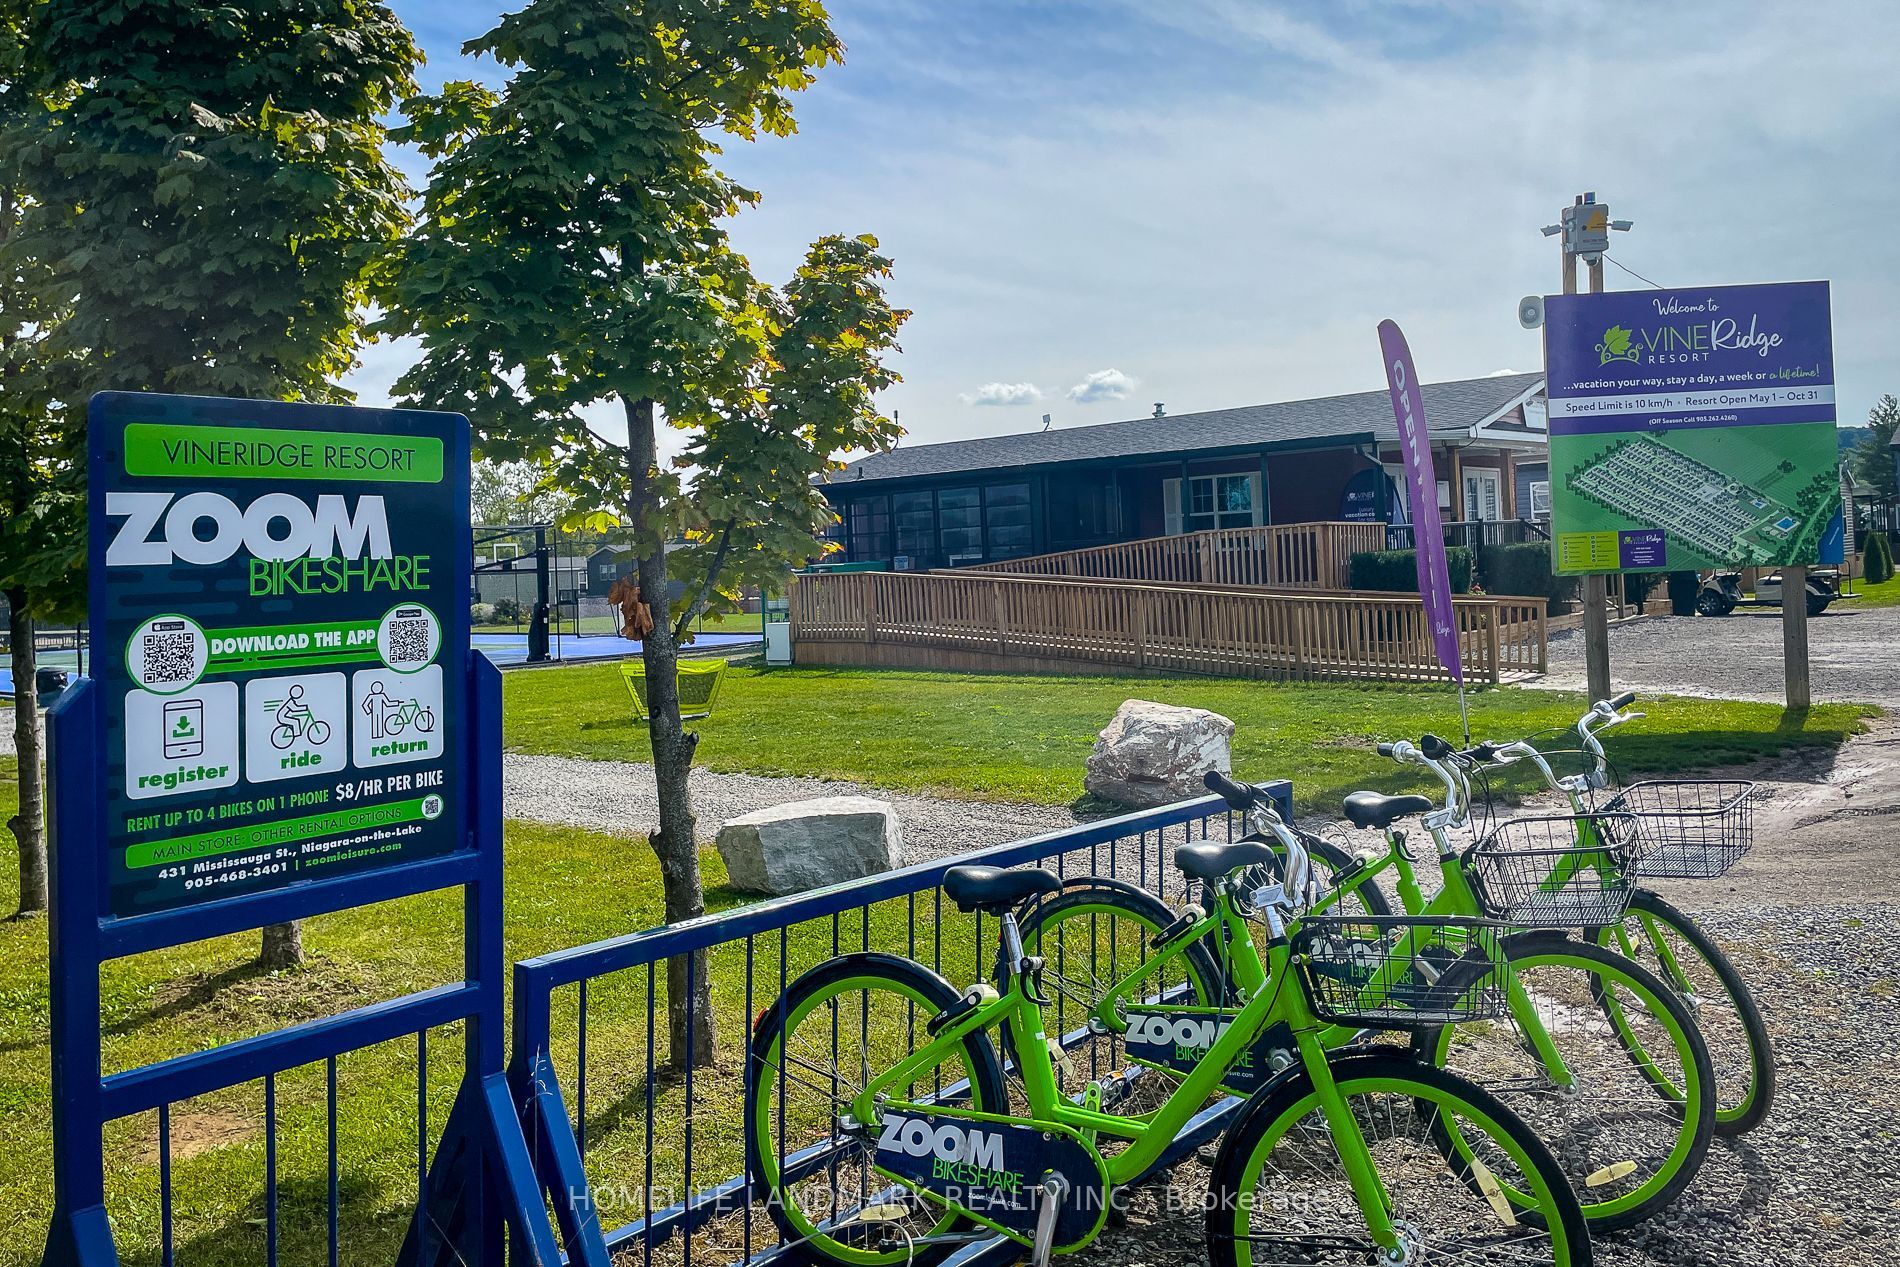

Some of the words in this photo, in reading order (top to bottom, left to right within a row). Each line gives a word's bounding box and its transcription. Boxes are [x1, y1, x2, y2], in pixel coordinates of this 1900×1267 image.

[1652, 296, 1706, 316] Welcome
[1706, 297, 1720, 312] to
[1648, 352, 1709, 364] RESORT
[1617, 379, 1640, 390] your
[1642, 377, 1665, 388] way,
[1666, 376, 1687, 387] stay
[1697, 373, 1718, 384] day,
[1726, 371, 1753, 381] week
[1755, 373, 1767, 381] or
[1769, 372, 1778, 380] a
[1779, 363, 1820, 380] lifetime!
[1566, 402, 1596, 413] Speed
[1598, 400, 1623, 410] Limit
[1625, 400, 1633, 409] is
[1635, 399, 1646, 408] 10
[1648, 398, 1673, 409] km/h
[1685, 395, 1717, 406] Resort
[1719, 395, 1747, 406] Open
[1749, 393, 1770, 404] May
[1772, 393, 1777, 401] 1
[1787, 391, 1805, 401] Oct
[1807, 391, 1818, 400] 31
[162, 439, 314, 468] VINERIDGE
[324, 444, 416, 471] RESORT
[106, 492, 393, 566] ZOOM
[250, 555, 430, 596] BIKESHARE
[211, 633, 309, 654] DOWNLOAD
[314, 631, 342, 647] THE
[346, 629, 376, 646] APP
[280, 750, 322, 769] ride
[371, 740, 428, 757] return
[138, 765, 229, 790] register
[127, 814, 161, 833] RENT
[165, 812, 183, 827] UP
[186, 809, 204, 823] TO
[207, 806, 215, 820] 4
[219, 801, 253, 819] BIKES
[256, 798, 275, 812] ON
[279, 796, 285, 809] 1
[290, 789, 329, 808] PHONE
[335, 779, 383, 802] $8/HR
[387, 774, 411, 793] PER
[416, 770, 443, 788] BIKE
[153, 843, 192, 860] MAIN
[199, 834, 246, 852] STORE:
[251, 826, 293, 843] OTHER
[300, 817, 344, 834] RENTAL
[348, 808, 402, 826] OPTIONS
[158, 866, 186, 879] 431
[193, 852, 271, 874] Mississauga
[301, 825, 422, 855] Niagara-on-the-Lake
[184, 862, 287, 890] 905-468-3401
[1126, 1014, 1231, 1048] ZOOM
[877, 1113, 1004, 1172] ZOOM
[932, 1157, 1024, 1196] BIKESHARE
